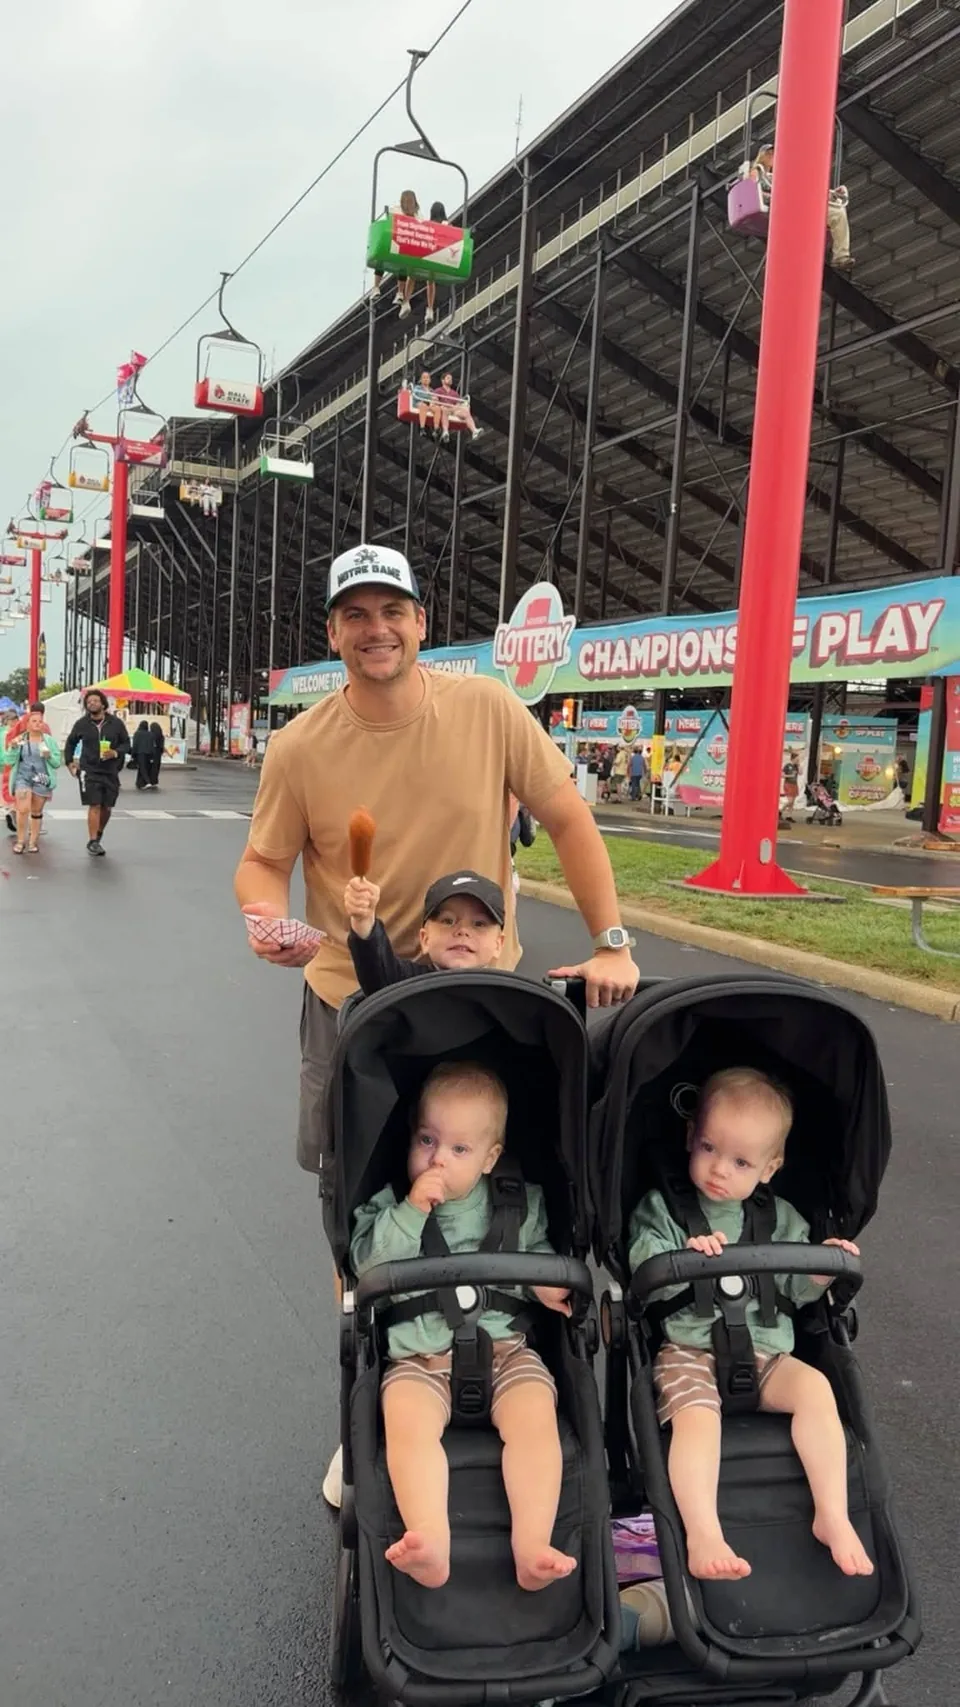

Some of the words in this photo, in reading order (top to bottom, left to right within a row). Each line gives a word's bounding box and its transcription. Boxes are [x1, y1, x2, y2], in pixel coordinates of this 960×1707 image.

[227, 396, 249, 404] STATE
[228, 391, 247, 399] BALL
[337, 565, 369, 587] NOTRE
[371, 564, 402, 582] DAME
[496, 621, 572, 663] LOTTERY
[579, 624, 738, 678] CHAMPIONS
[811, 600, 946, 664] PLAY
[292, 672, 330, 694] WELCOME
[332, 671, 343, 690] TO
[677, 718, 702, 729] HERE
